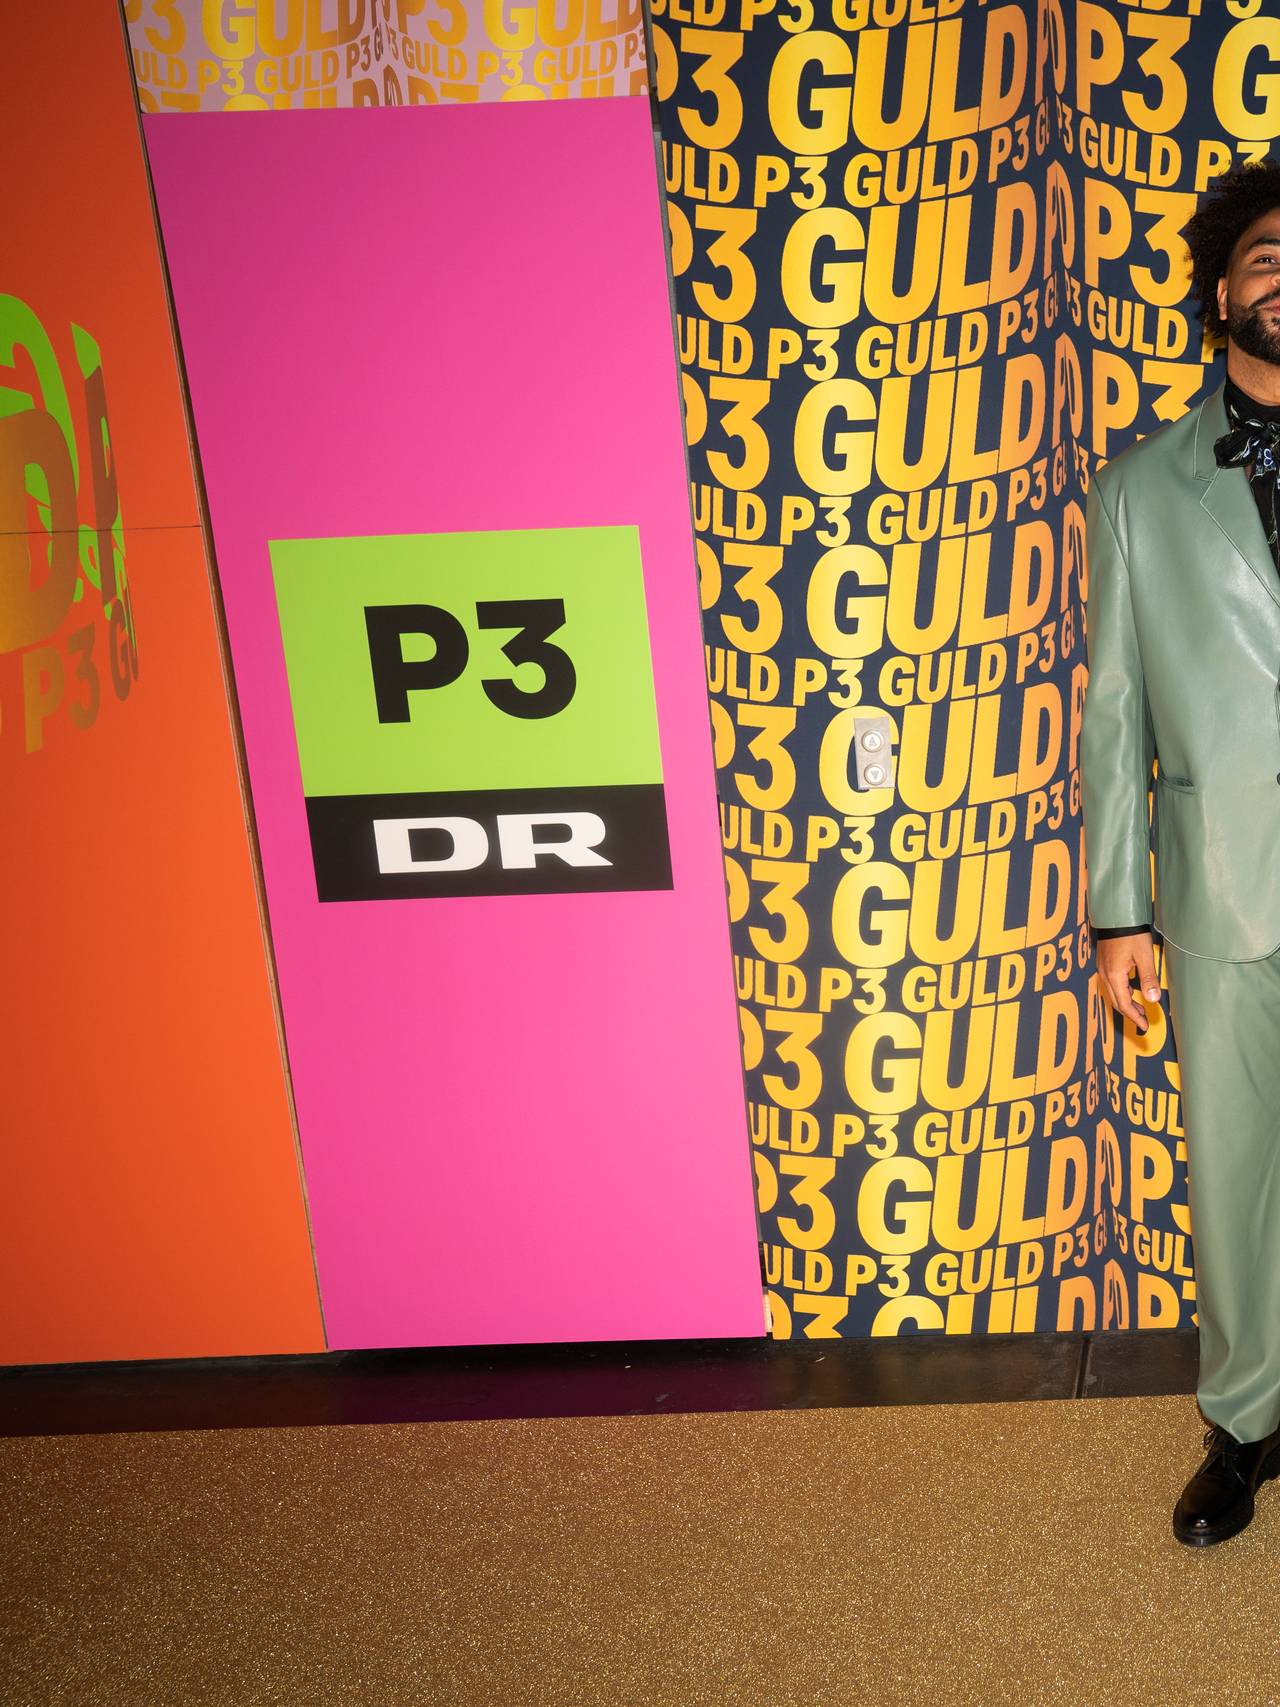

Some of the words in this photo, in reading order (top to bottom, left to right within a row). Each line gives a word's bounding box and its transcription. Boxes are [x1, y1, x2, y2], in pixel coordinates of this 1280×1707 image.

[196, 60, 245, 96] P3
[254, 50, 340, 95] GULD
[346, 35, 372, 80] P3
[402, 36, 468, 82] GULD
[476, 51, 525, 87] P3
[533, 39, 618, 85] GULD
[767, 4, 1029, 155] GULD
[1075, 0, 1192, 134] P3
[753, 154, 828, 210] P3
[843, 138, 979, 209] GULD
[987, 116, 1030, 183] P3
[1079, 116, 1182, 187] GULD
[780, 181, 1037, 328] GULD
[1083, 176, 1199, 307] P3
[766, 327, 840, 381] P3
[855, 311, 989, 380] GULD
[997, 288, 1039, 355] P3
[1087, 290, 1189, 359] GULD
[793, 353, 1046, 496] GULD
[779, 495, 852, 547] P3
[866, 480, 998, 546] GULD
[1006, 458, 1048, 522] P3
[806, 519, 1055, 659] GULD
[22, 622, 101, 754] P3
[364, 598, 576, 724] P3
[792, 657, 864, 708] P3
[877, 643, 1008, 707] GULD
[1015, 622, 1057, 684] P3
[818, 682, 1063, 816] GULD
[373, 811, 614, 874] DR
[805, 815, 875, 864] P3
[889, 801, 1017, 863] GULD
[1024, 780, 1065, 841] P3
[831, 838, 1072, 968] GULD
[818, 966, 888, 1015] P3
[901, 954, 1026, 1014] GULD
[1034, 933, 1073, 993] P3
[844, 990, 1080, 1115] GULD
[831, 1113, 900, 1159] P3
[912, 1100, 1036, 1158] GULD
[1043, 1082, 1081, 1137] P3
[1125, 1082, 1187, 1138] GUL
[856, 1135, 1089, 1255] GULD
[844, 1254, 911, 1298] P3
[924, 1242, 1045, 1297] GULD
[1051, 1222, 1090, 1277] P3
[1133, 1223, 1195, 1278] GUL
